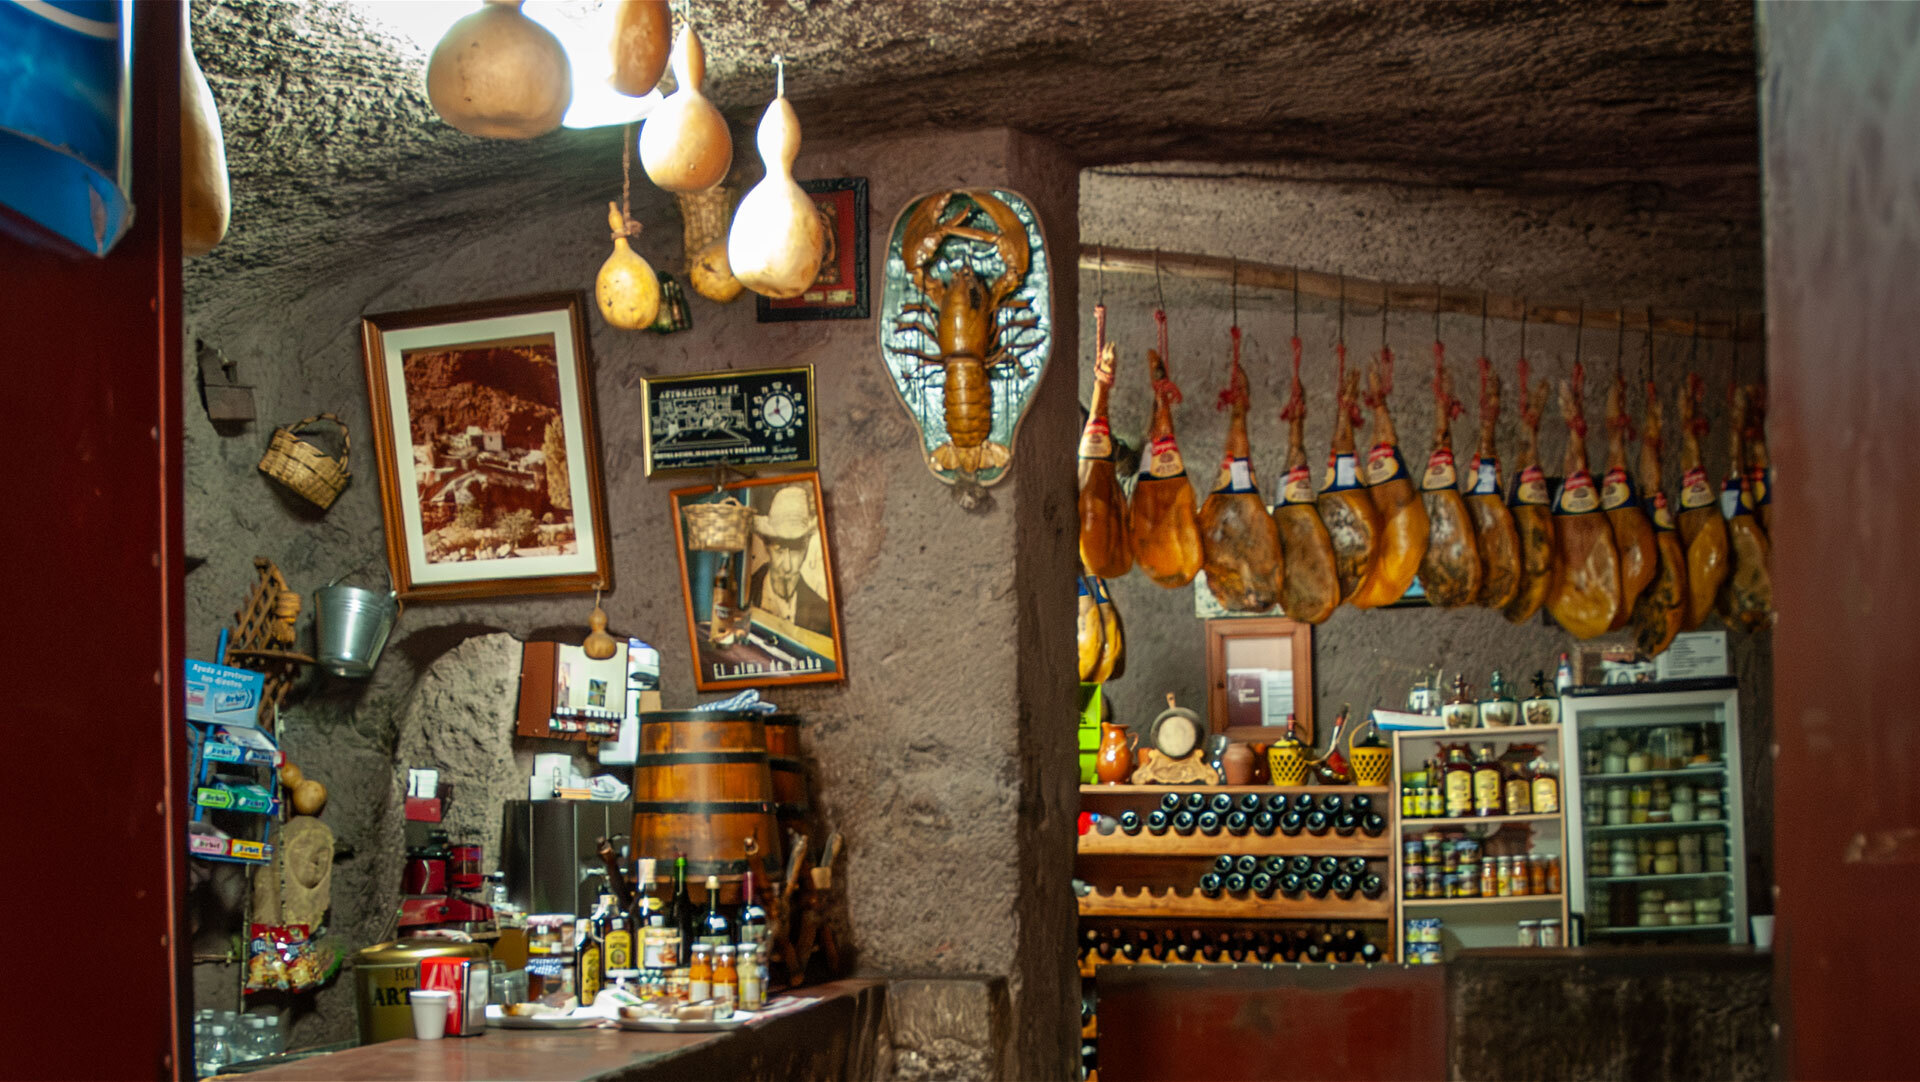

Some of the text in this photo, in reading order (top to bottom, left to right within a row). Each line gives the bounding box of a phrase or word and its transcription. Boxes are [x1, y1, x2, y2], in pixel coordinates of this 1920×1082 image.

[712, 662, 726, 680] El
[734, 661, 763, 675] alma
[769, 658, 784, 672] de
[395, 967, 417, 982] RO
[374, 986, 417, 1007] ART
